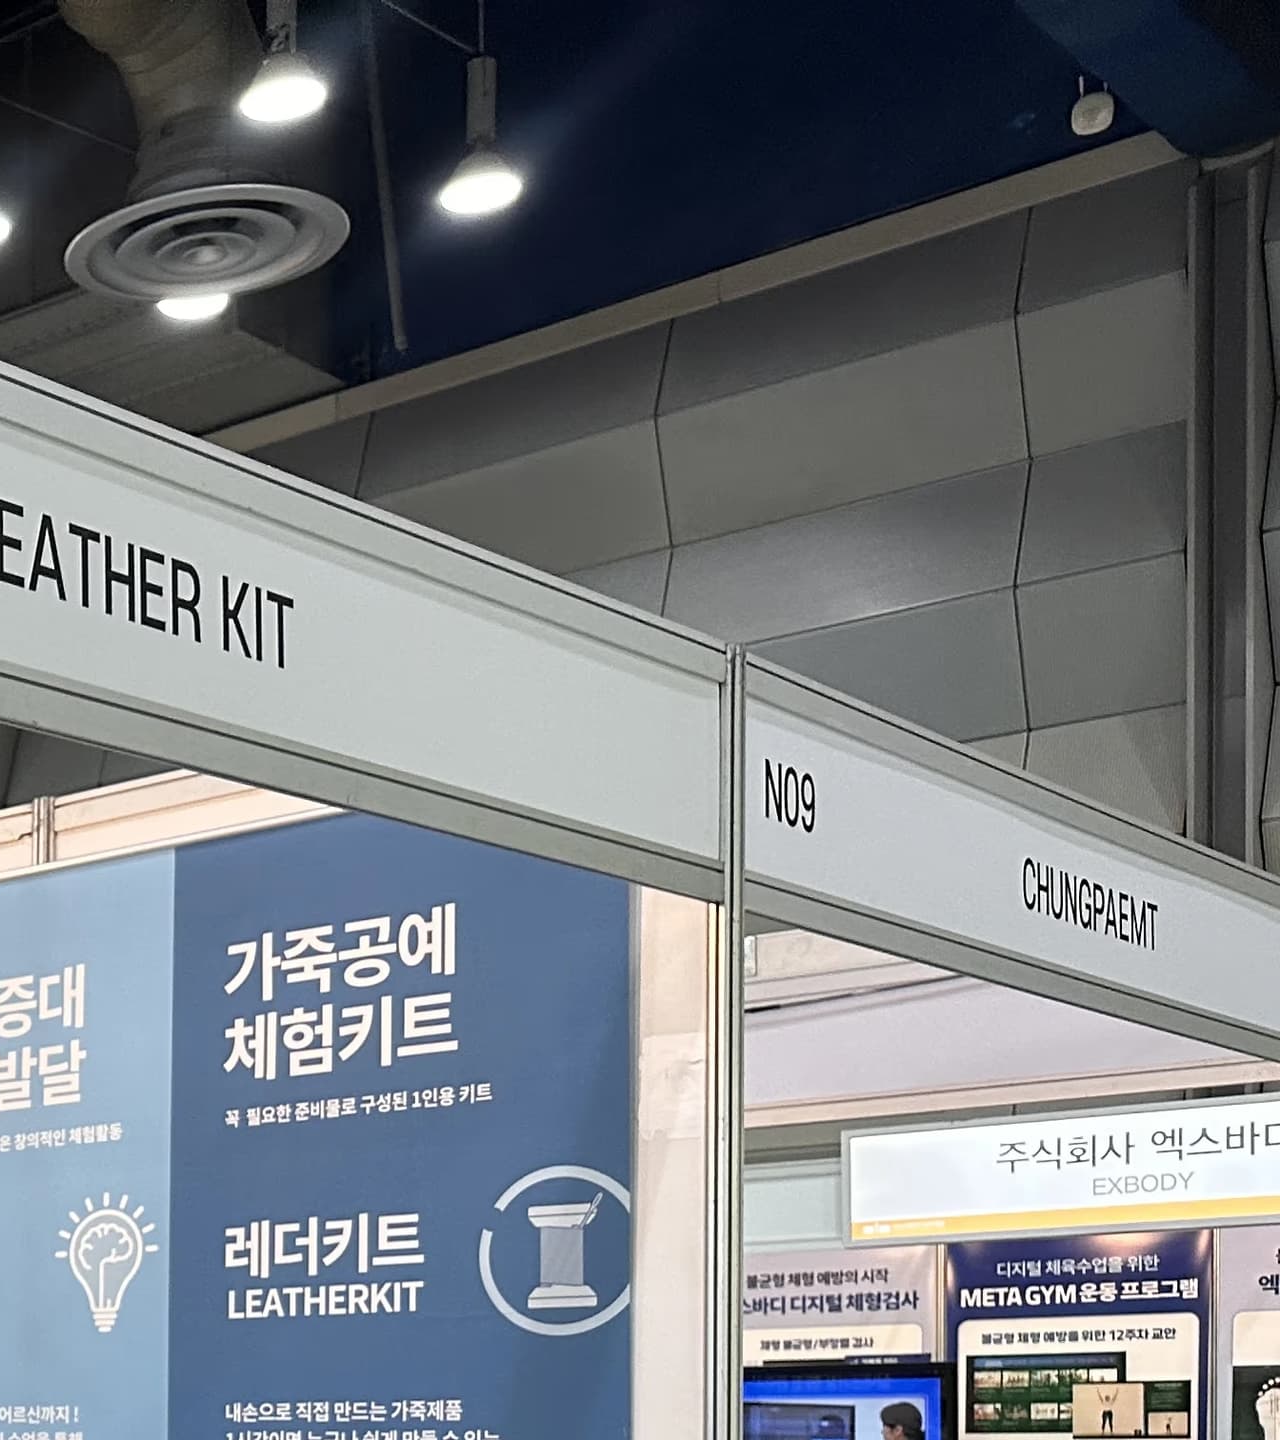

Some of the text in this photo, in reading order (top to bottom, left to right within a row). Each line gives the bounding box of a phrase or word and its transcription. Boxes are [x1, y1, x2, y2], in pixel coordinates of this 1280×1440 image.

[218, 580, 295, 670] KIT
[764, 758, 816, 833] N09
[1022, 857, 1159, 951] CHUNGPAEMT
[223, 901, 457, 1001] 가죽공예
[222, 992, 459, 1081] 체험키트
[224, 1083, 493, 1128] 꼭 필요한 준비물로 구성된 1인용 키트
[14, 1130, 66, 1150] 창의적인
[68, 1123, 123, 1145] 체험활동
[995, 1131, 1135, 1174] 주식회사
[1092, 1172, 1195, 1197] EXBODY
[223, 1212, 425, 1279] 레더키트
[747, 1268, 888, 1288] 불균형 체형 예방의 시작
[996, 1255, 1160, 1278] 디지털 체육수업을 위한
[227, 1281, 425, 1320] LEATHERKIT
[791, 1291, 920, 1314] 디지털 체형검사
[960, 1278, 1199, 1308] META GYM 운동 프로그램
[1082, 1330, 1106, 1342] 위한
[224, 1400, 463, 1422] 내손으로 직접 만드는 가죽제품
